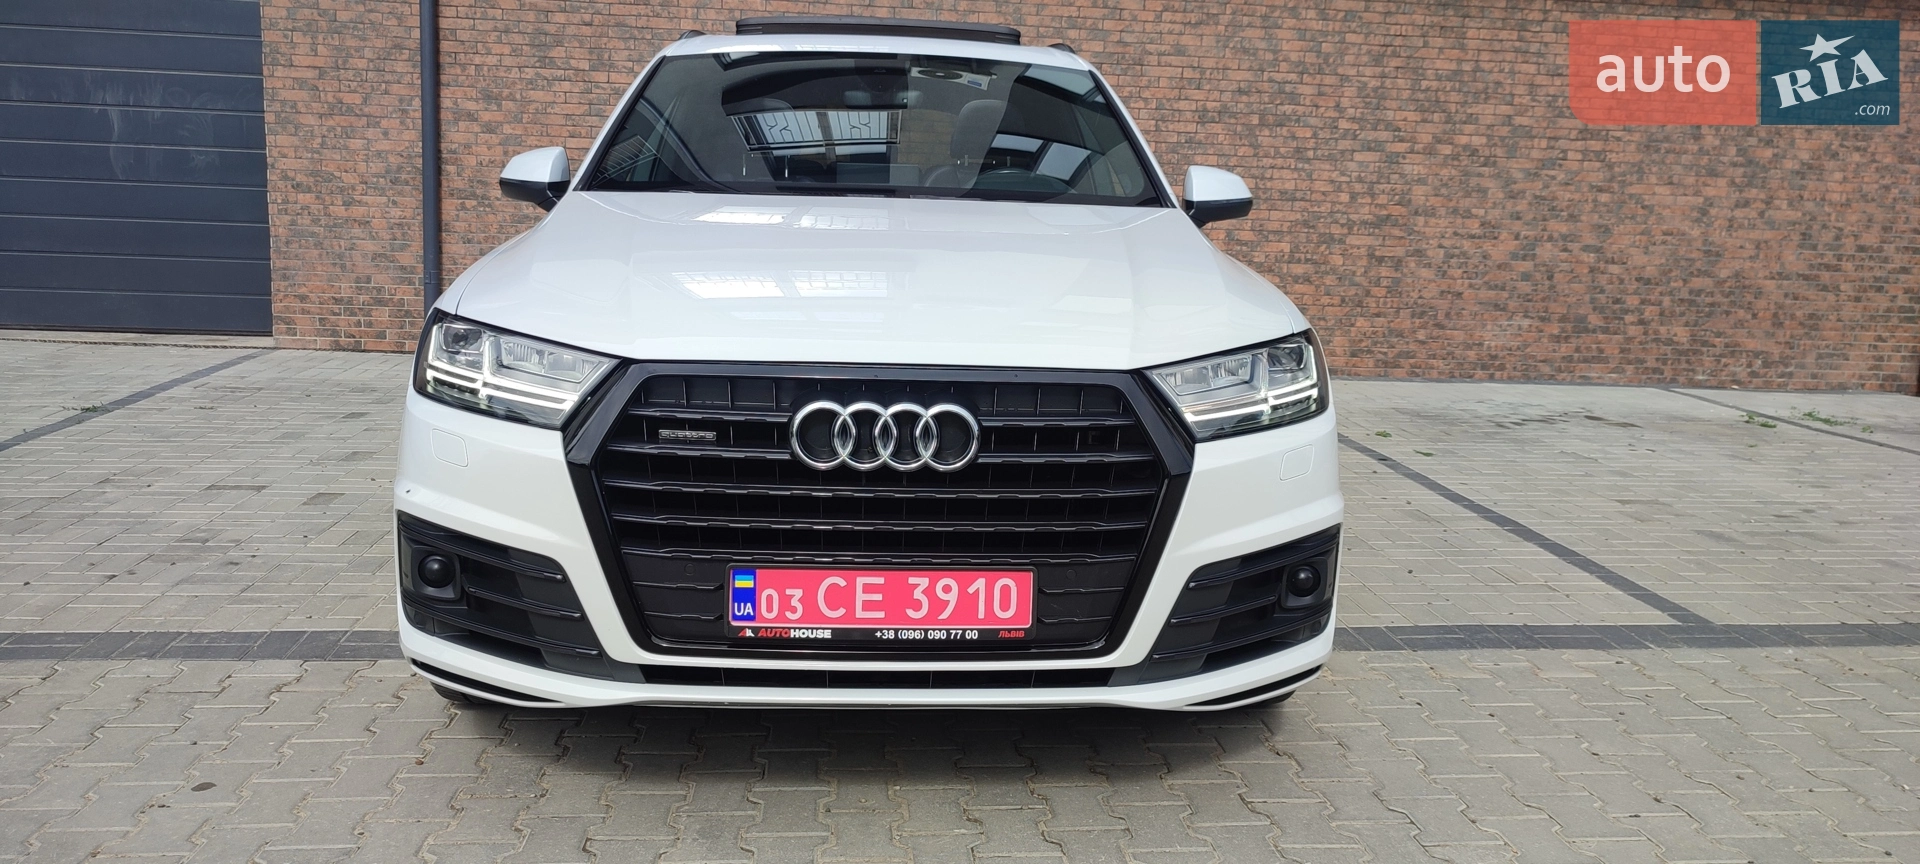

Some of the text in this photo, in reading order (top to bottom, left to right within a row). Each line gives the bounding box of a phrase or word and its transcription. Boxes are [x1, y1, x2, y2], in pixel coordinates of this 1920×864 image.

[760, 576, 1018, 620] 03 CE 3910
[734, 602, 754, 616] UA
[757, 628, 832, 639] AUTOHOUSE
[874, 629, 979, 640] +38 (096) 090 77 00
